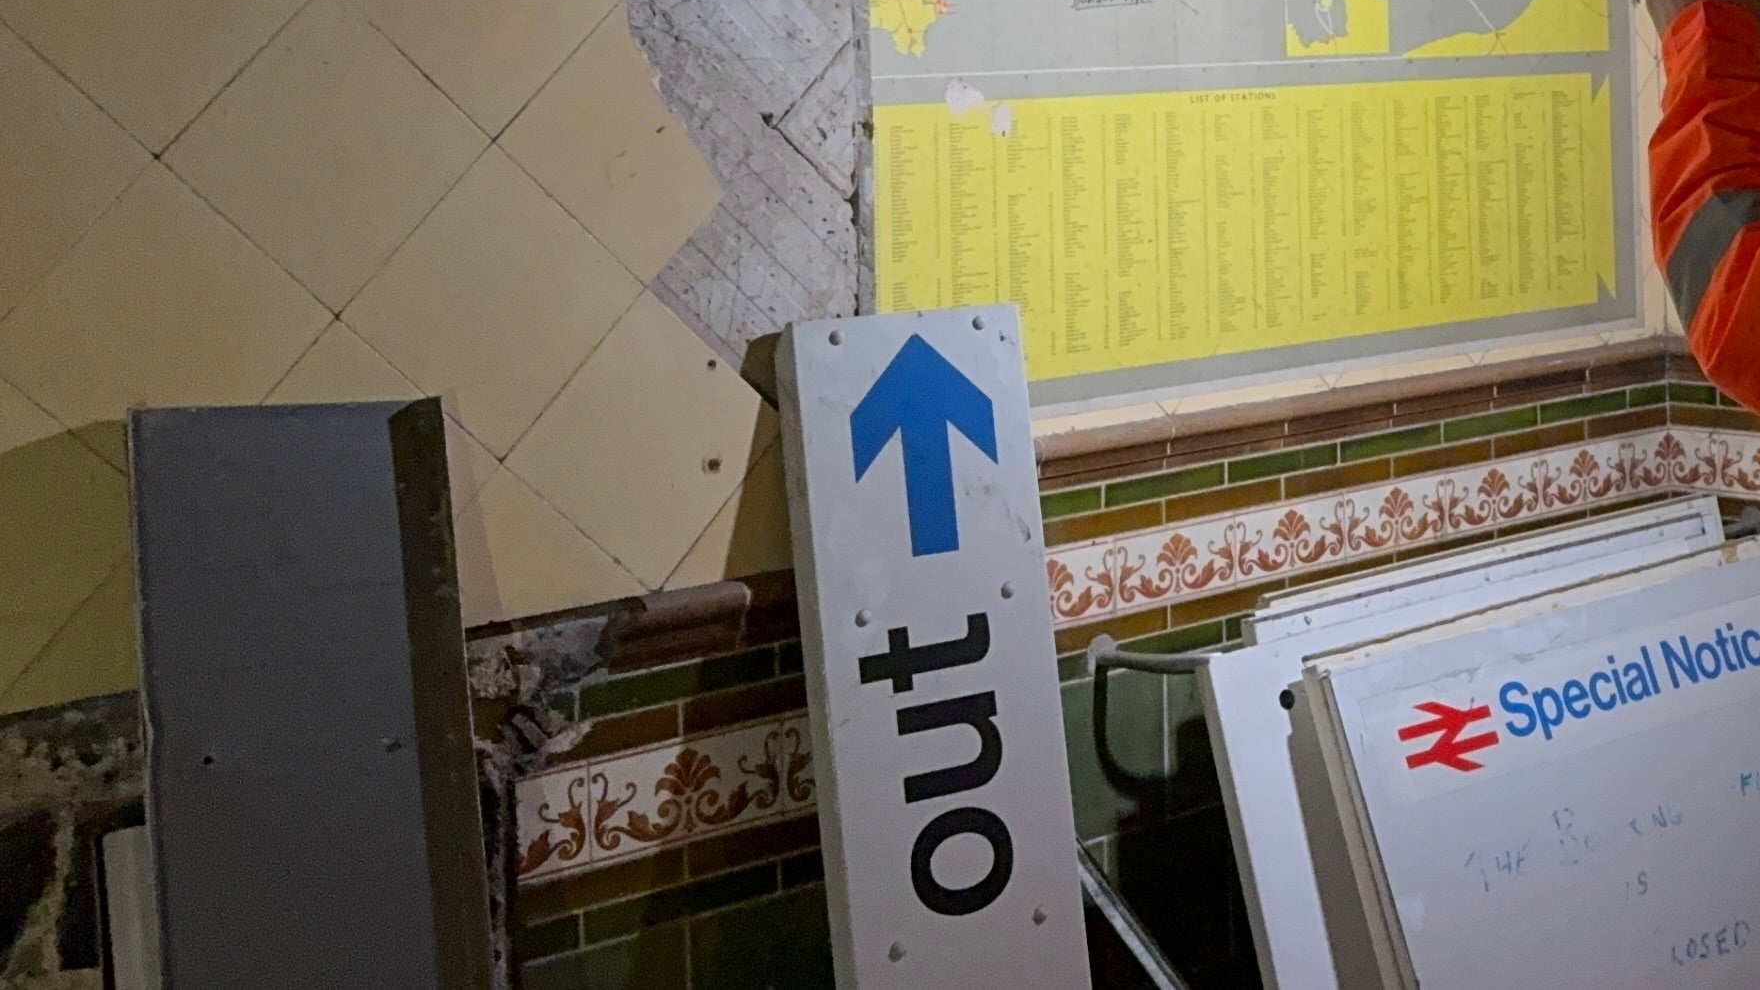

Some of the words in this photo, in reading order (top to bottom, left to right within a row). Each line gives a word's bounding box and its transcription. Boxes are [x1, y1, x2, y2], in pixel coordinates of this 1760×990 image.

[1190, 95, 1209, 104] LIST
[1214, 94, 1226, 103] OF
[1231, 92, 1276, 102] STATIONS
[1498, 645, 1661, 741] Special
[857, 611, 1014, 917] out
